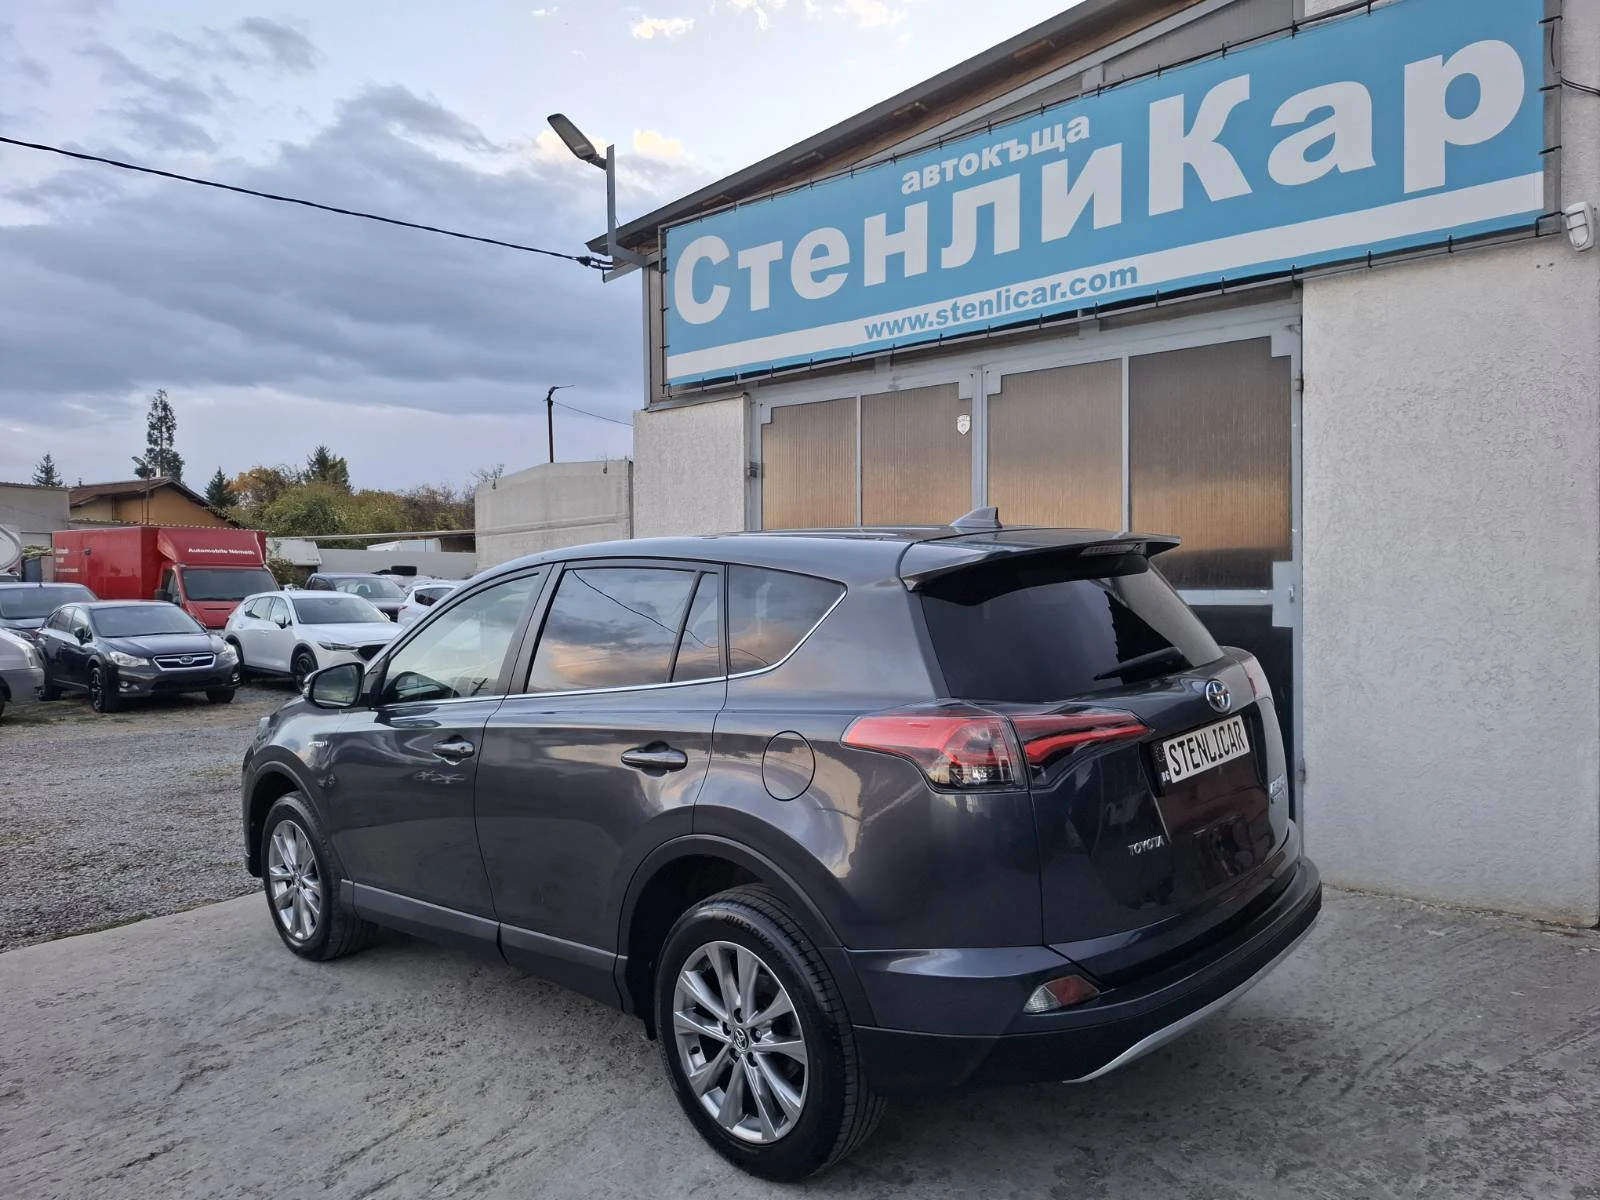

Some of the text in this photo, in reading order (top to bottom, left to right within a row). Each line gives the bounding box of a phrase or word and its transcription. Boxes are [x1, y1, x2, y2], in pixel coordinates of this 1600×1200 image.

[902, 116, 1090, 195] автокъща
[865, 265, 1137, 340] www.stenlicar.com
[1168, 720, 1246, 776] STENLICAR
[1127, 834, 1165, 856] TOYOTA
